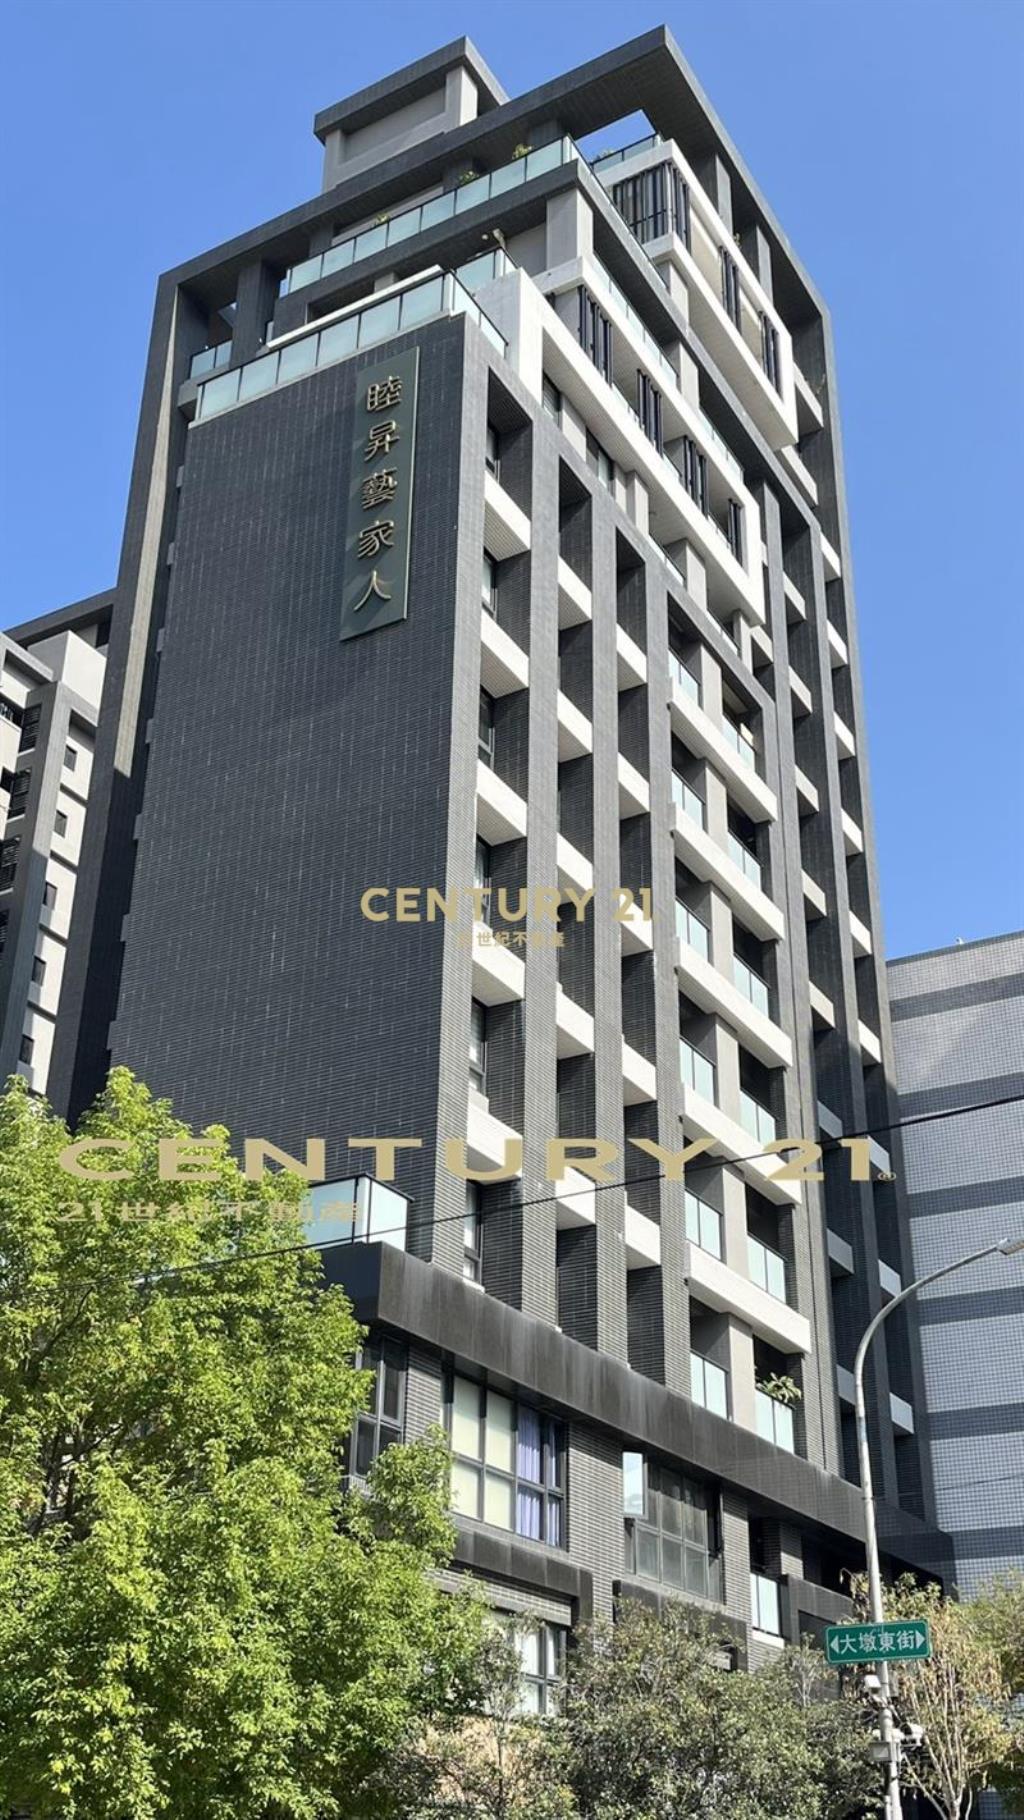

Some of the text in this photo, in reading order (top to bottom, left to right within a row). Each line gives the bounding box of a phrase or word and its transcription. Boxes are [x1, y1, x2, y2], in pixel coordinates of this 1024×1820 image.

[354, 375, 402, 612] 睦昇藝家人
[840, 1630, 914, 1655] 大墩東街
